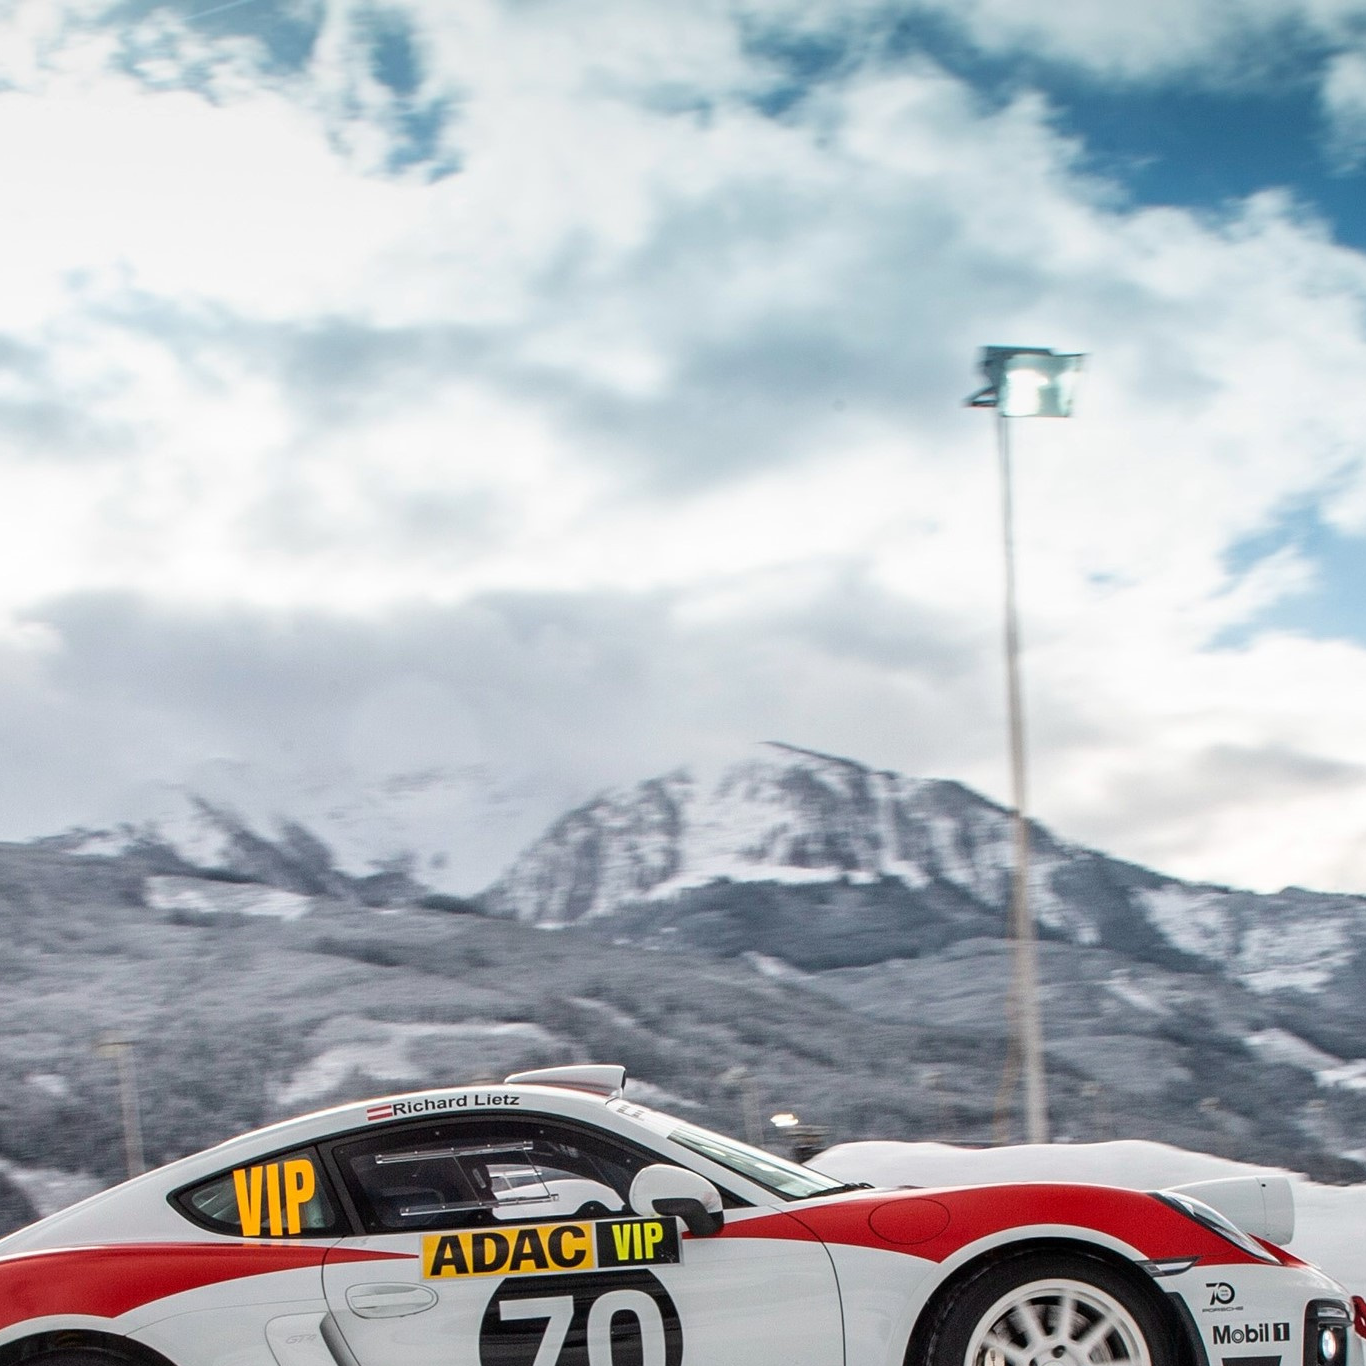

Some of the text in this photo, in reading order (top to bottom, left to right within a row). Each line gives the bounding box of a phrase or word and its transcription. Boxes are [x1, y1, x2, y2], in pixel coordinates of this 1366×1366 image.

[392, 1094, 520, 1116] Richard Lietz
[233, 1158, 315, 1237] VIP
[430, 1222, 664, 1276] ADAC VIP
[1205, 1282, 1235, 1306] 70
[1212, 1323, 1269, 1345] Mobil
